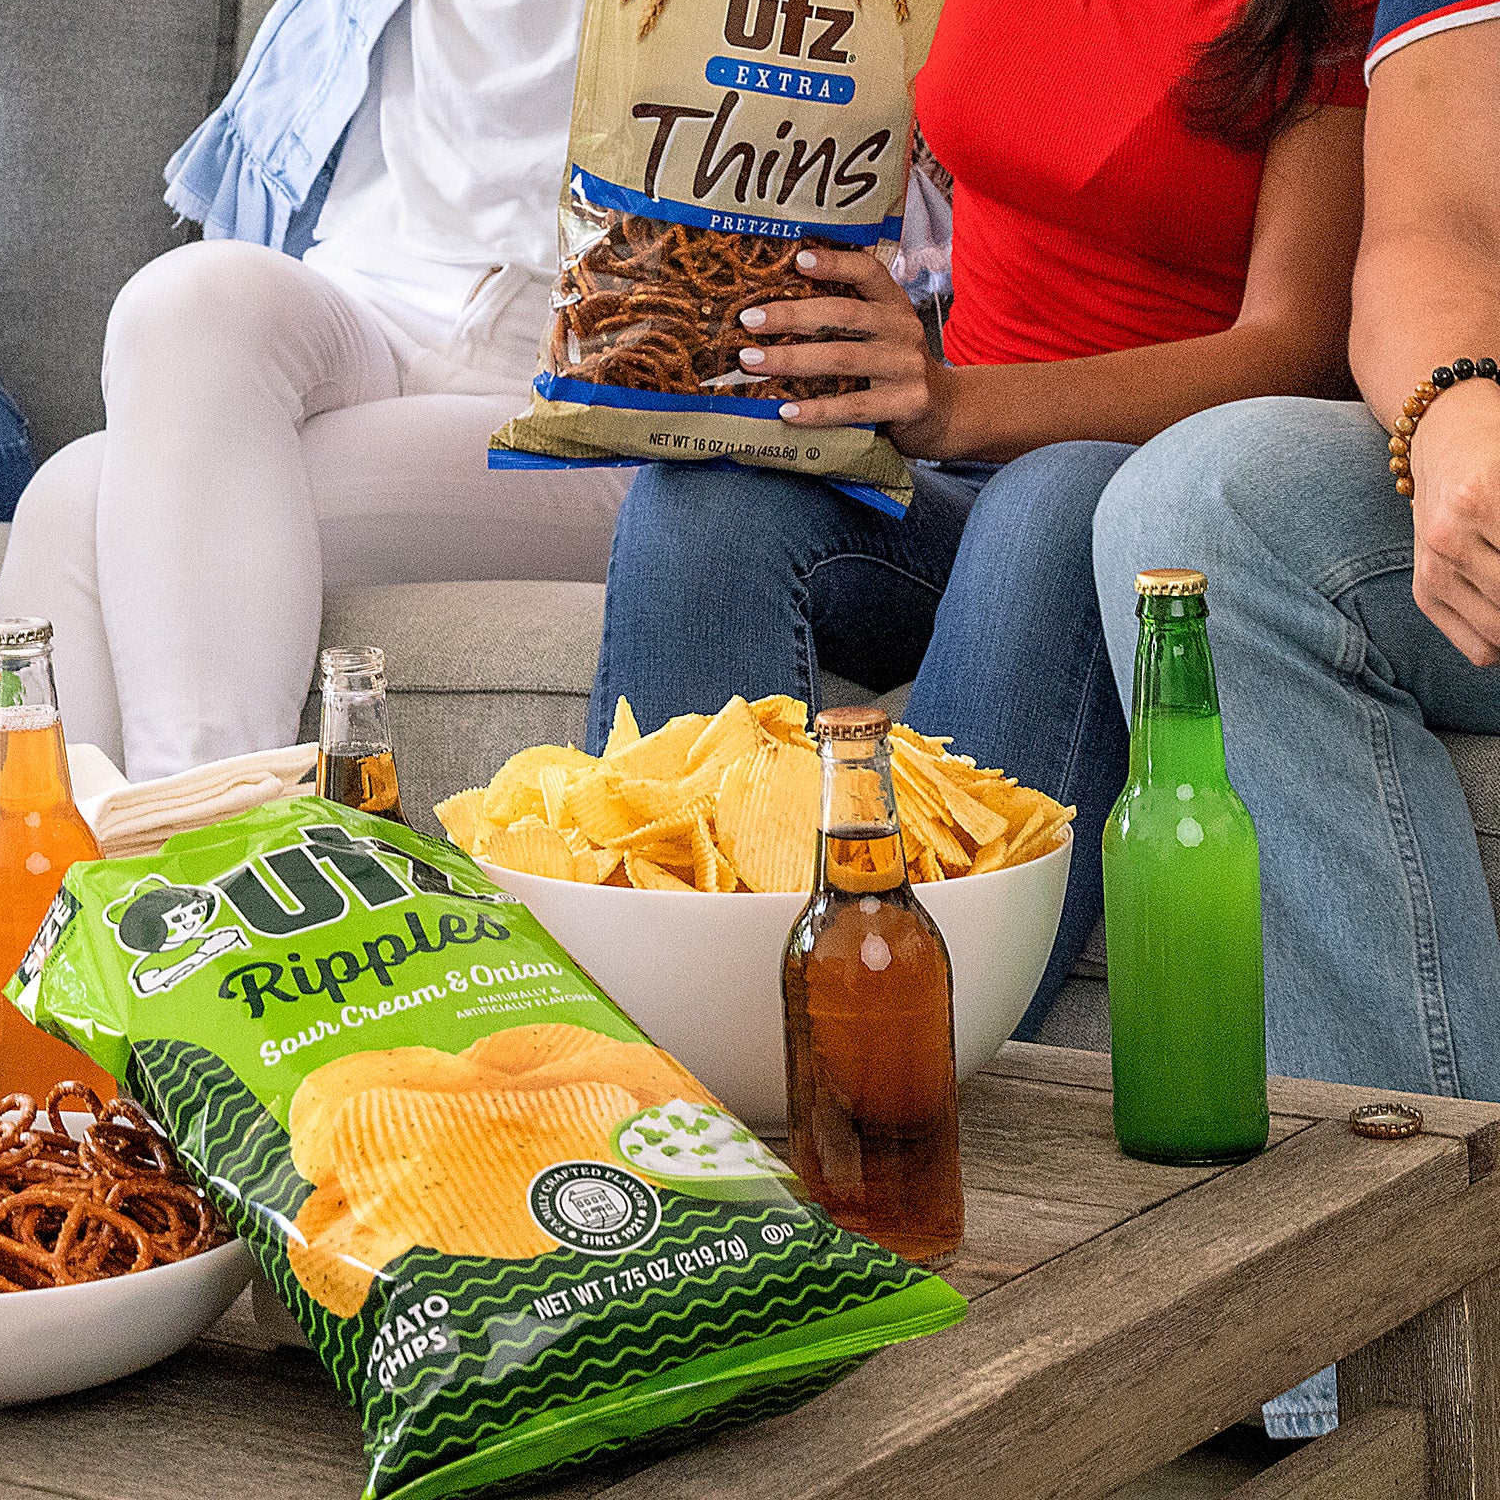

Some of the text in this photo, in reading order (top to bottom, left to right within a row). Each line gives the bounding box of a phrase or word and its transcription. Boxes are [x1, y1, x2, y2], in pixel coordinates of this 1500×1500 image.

[734, 65, 832, 99] EXTRA
[632, 90, 892, 208] Thins
[709, 214, 802, 238] PRETZELS
[649, 433, 671, 447] NET
[673, 435, 690, 449] WT
[693, 438, 706, 452] 16
[708, 439, 723, 454] OZ
[757, 445, 798, 462] (453.6g)
[218, 911, 512, 1020] Ripples
[258, 959, 563, 1067] Sour Cream & Onion
[455, 1000, 533, 1019] ARTIFICIALLY
[476, 986, 561, 1005] NATURALLY &
[538, 1166, 648, 1234] FAMILY CRAFTED FLAVOR
[580, 1218, 647, 1247] SINCE 1921
[533, 1234, 749, 1320] NET WT 7.75 OZ (219.7g)
[378, 1325, 448, 1390] CHIPS
